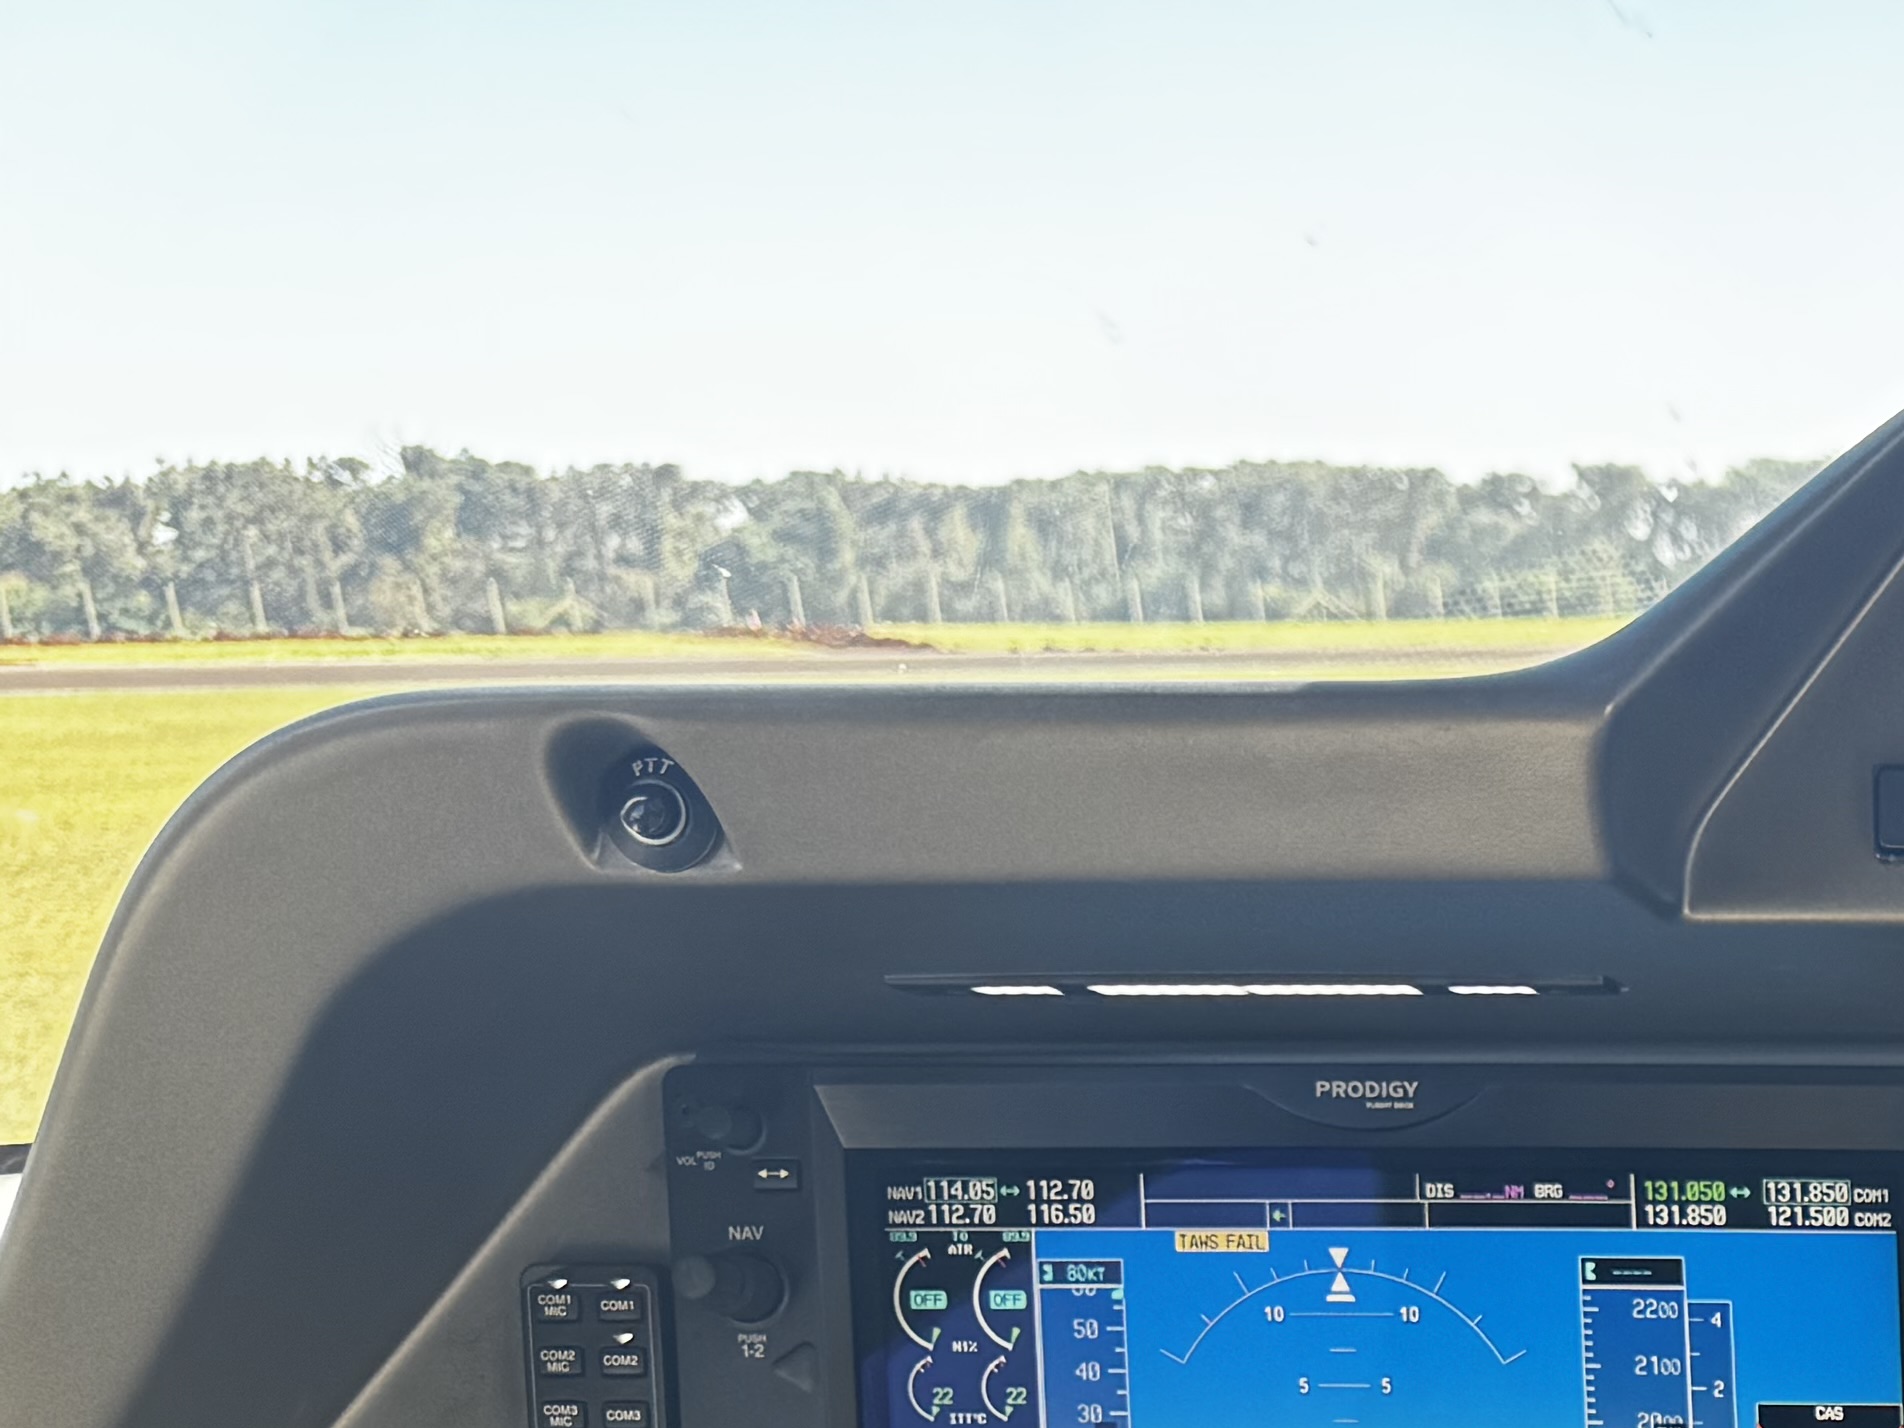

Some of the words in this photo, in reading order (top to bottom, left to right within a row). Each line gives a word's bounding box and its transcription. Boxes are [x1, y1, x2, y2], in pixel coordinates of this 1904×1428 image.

[924, 1178, 995, 1203] 114.05
[1179, 1233, 1219, 1250] TAWS
[1225, 1233, 1265, 1251] FAIL
